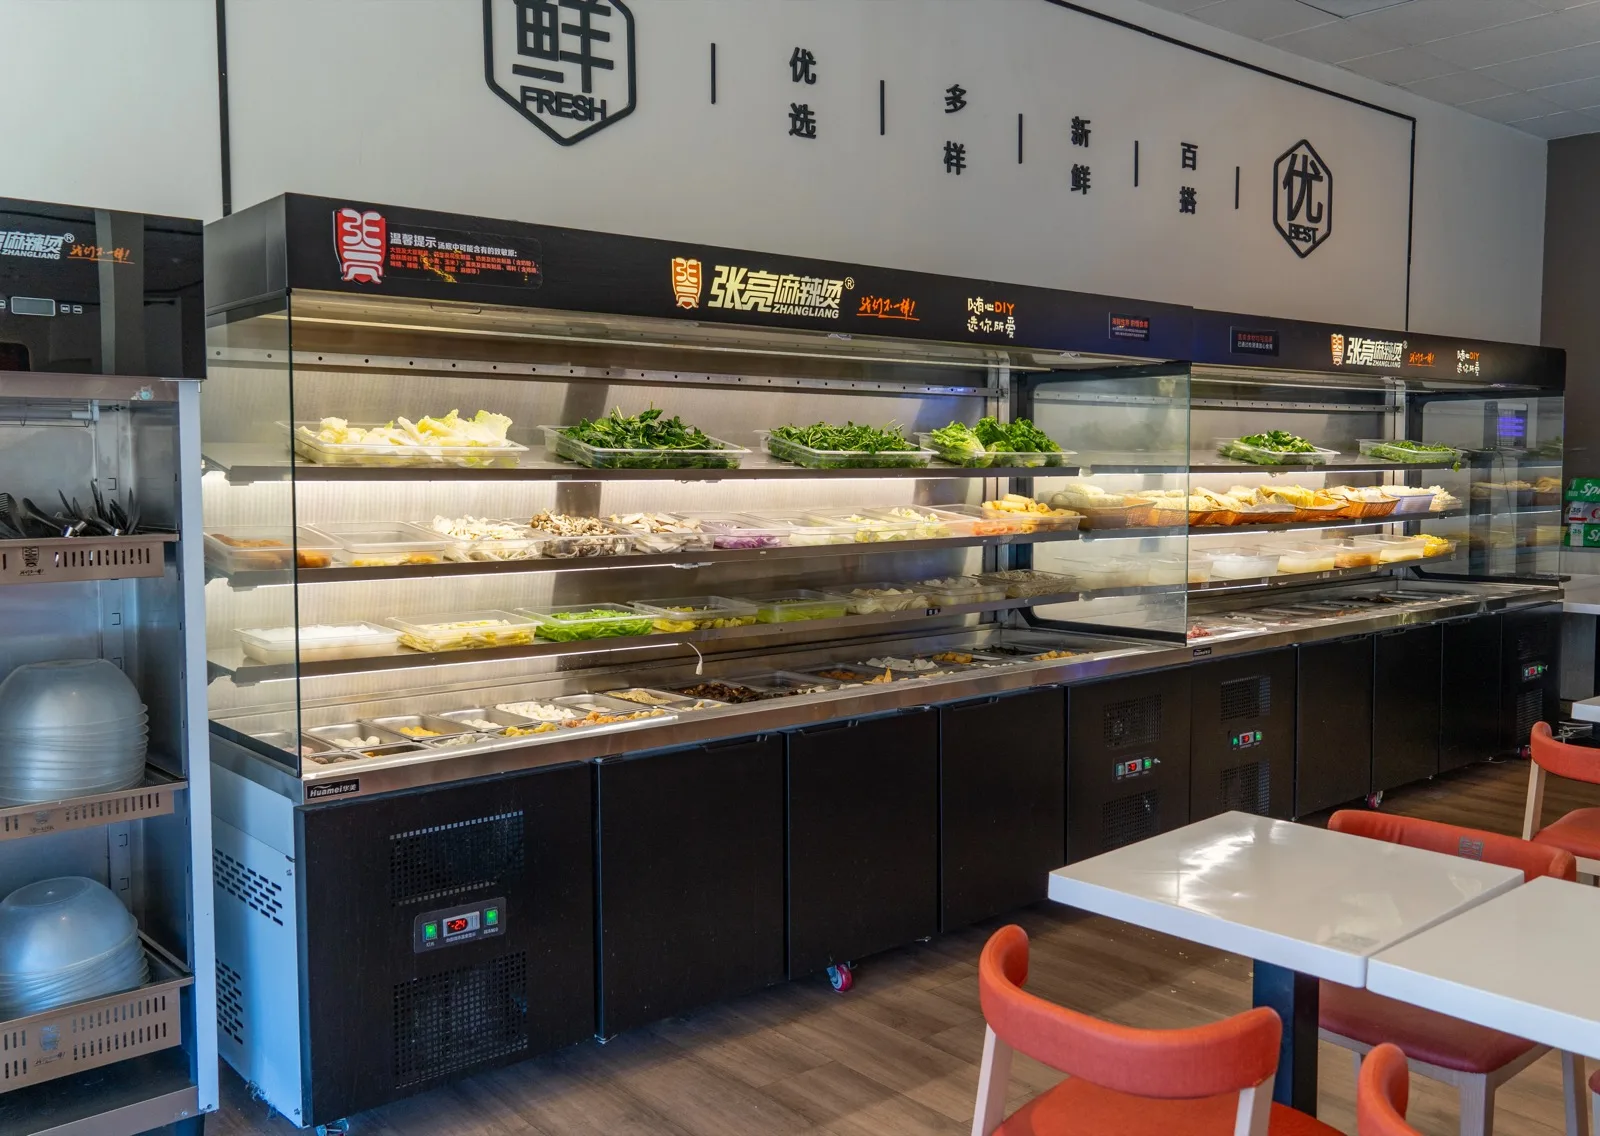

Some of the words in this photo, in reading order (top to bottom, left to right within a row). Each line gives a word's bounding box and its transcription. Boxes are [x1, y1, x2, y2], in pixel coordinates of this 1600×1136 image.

[519, 85, 608, 121] FRESH
[788, 47, 817, 139] 优选
[943, 83, 968, 176] 多样
[1070, 116, 1092, 195] 新鲜
[0, 230, 64, 254] 麻辣烫
[389, 232, 437, 248] 温馨提示
[1288, 222, 1319, 245] BEST
[1, 248, 61, 260] ZHANGLIANG
[707, 265, 844, 313] 张亮麻辣烫
[771, 303, 840, 319] ZHANGLIANG
[1346, 337, 1403, 365] 张亮麻辣烫
[1372, 359, 1402, 368] ZHANGLIANG
